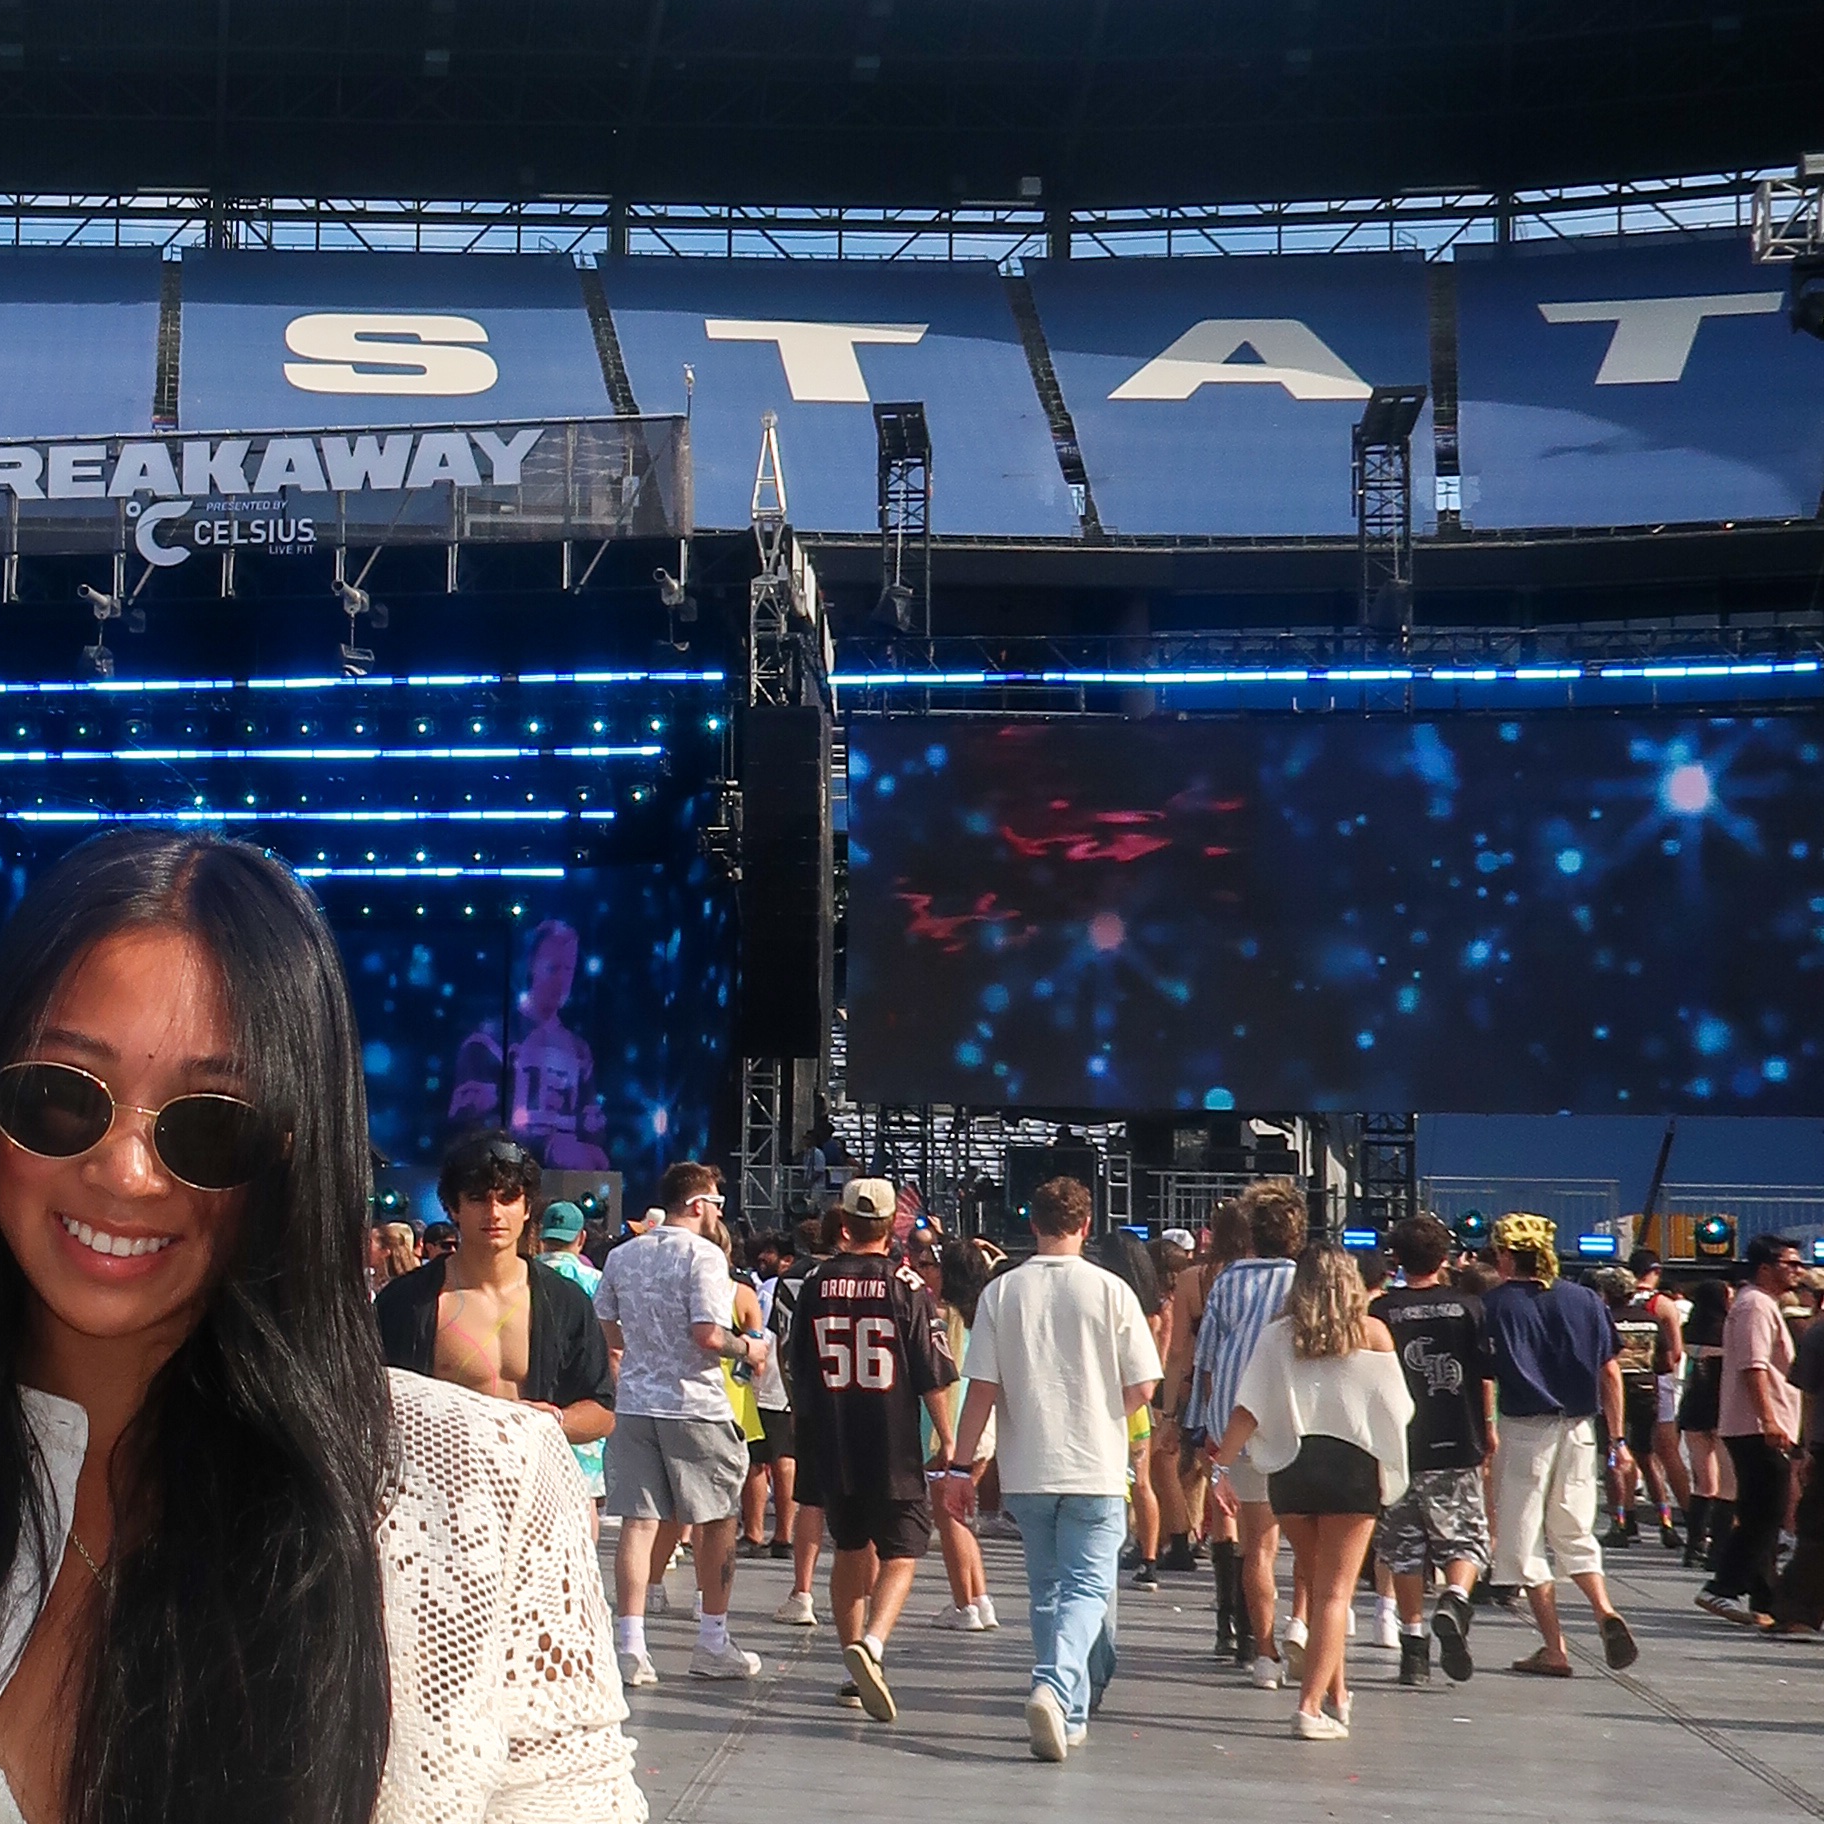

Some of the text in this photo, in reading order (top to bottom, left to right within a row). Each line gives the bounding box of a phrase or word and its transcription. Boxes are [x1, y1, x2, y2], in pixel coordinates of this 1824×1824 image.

[206, 499, 289, 512] PRESENTED BY
[269, 544, 315, 555] LIVE FIT
[820, 1278, 887, 1299] BROOKING
[813, 1316, 897, 1392] 56
